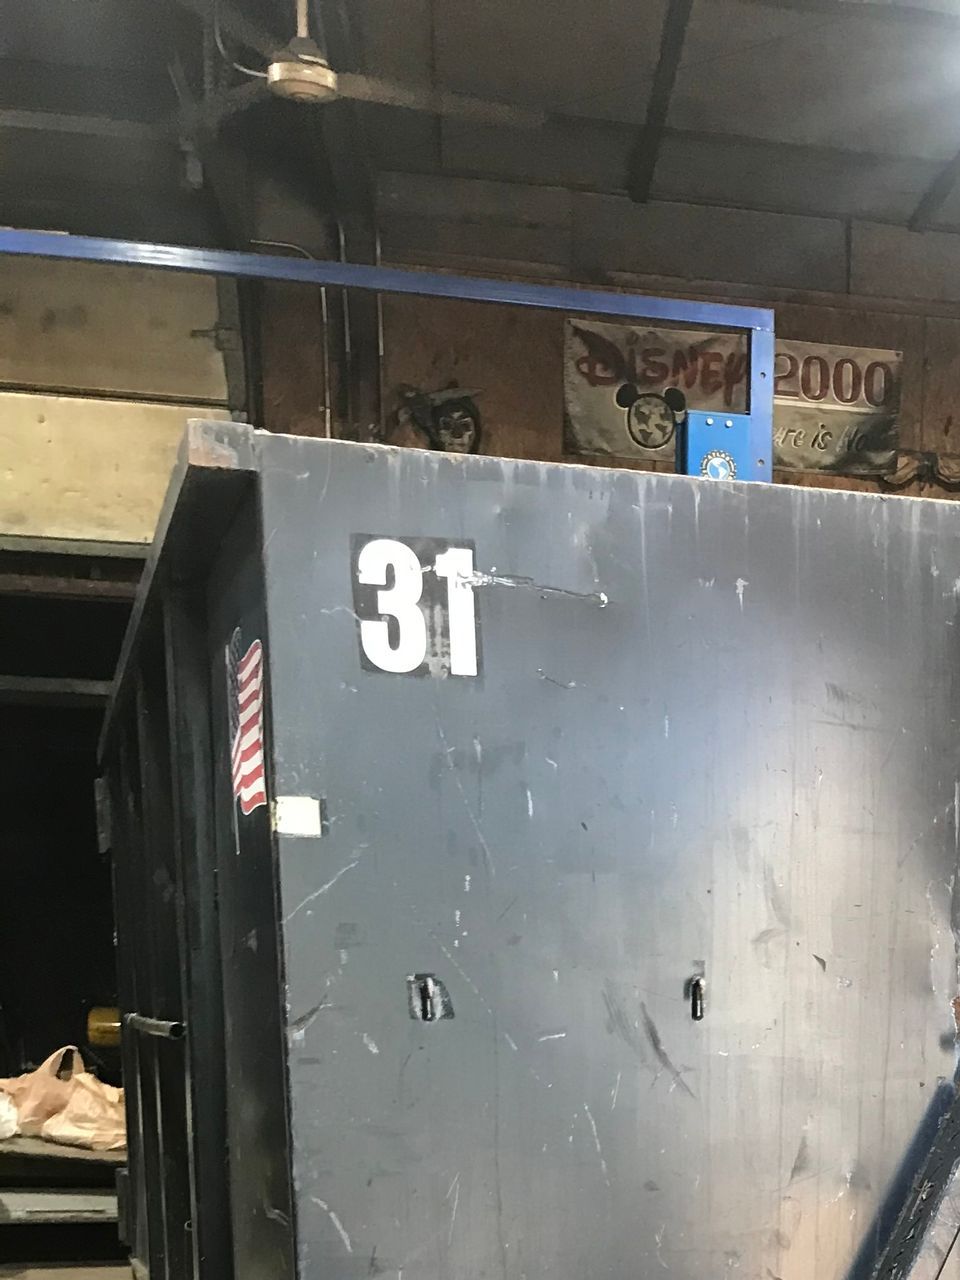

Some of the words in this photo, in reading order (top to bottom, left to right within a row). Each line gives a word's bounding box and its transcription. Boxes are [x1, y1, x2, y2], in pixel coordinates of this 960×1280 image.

[774, 353, 894, 407] 2000
[810, 422, 833, 452] is
[358, 538, 478, 676] 31
